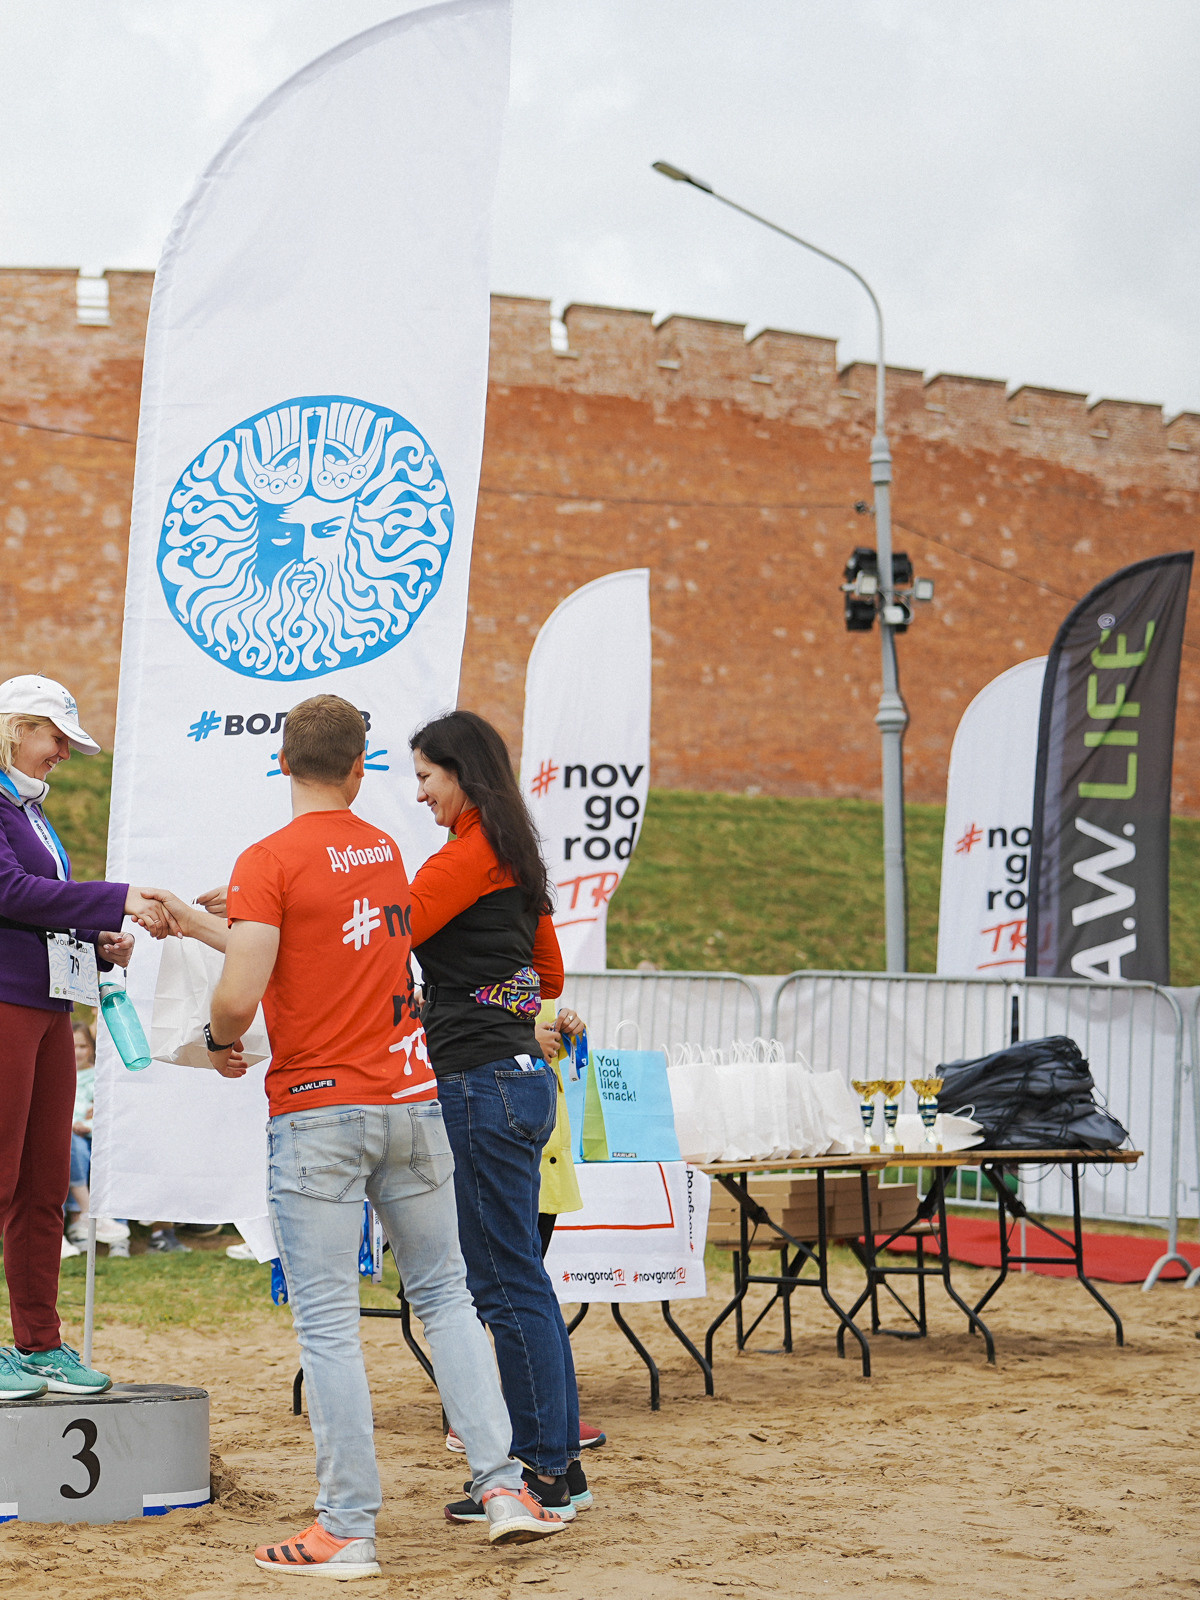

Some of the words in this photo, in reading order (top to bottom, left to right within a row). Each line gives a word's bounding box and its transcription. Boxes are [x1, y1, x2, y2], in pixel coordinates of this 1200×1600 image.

[531, 758, 644, 798] #nov
[585, 795, 640, 830] go
[564, 822, 637, 860] rod
[956, 823, 1032, 853] #no
[326, 838, 394, 873] Дубовой
[1006, 854, 1027, 884] g
[557, 872, 619, 909] TR
[987, 889, 1027, 910] ro
[69, 954, 80, 976] 79
[596, 1055, 620, 1067] You
[598, 1067, 622, 1078] look
[600, 1078, 620, 1089] like
[621, 1081, 628, 1090] a
[602, 1090, 637, 1102] snack!
[60, 1418, 101, 1499] 3
